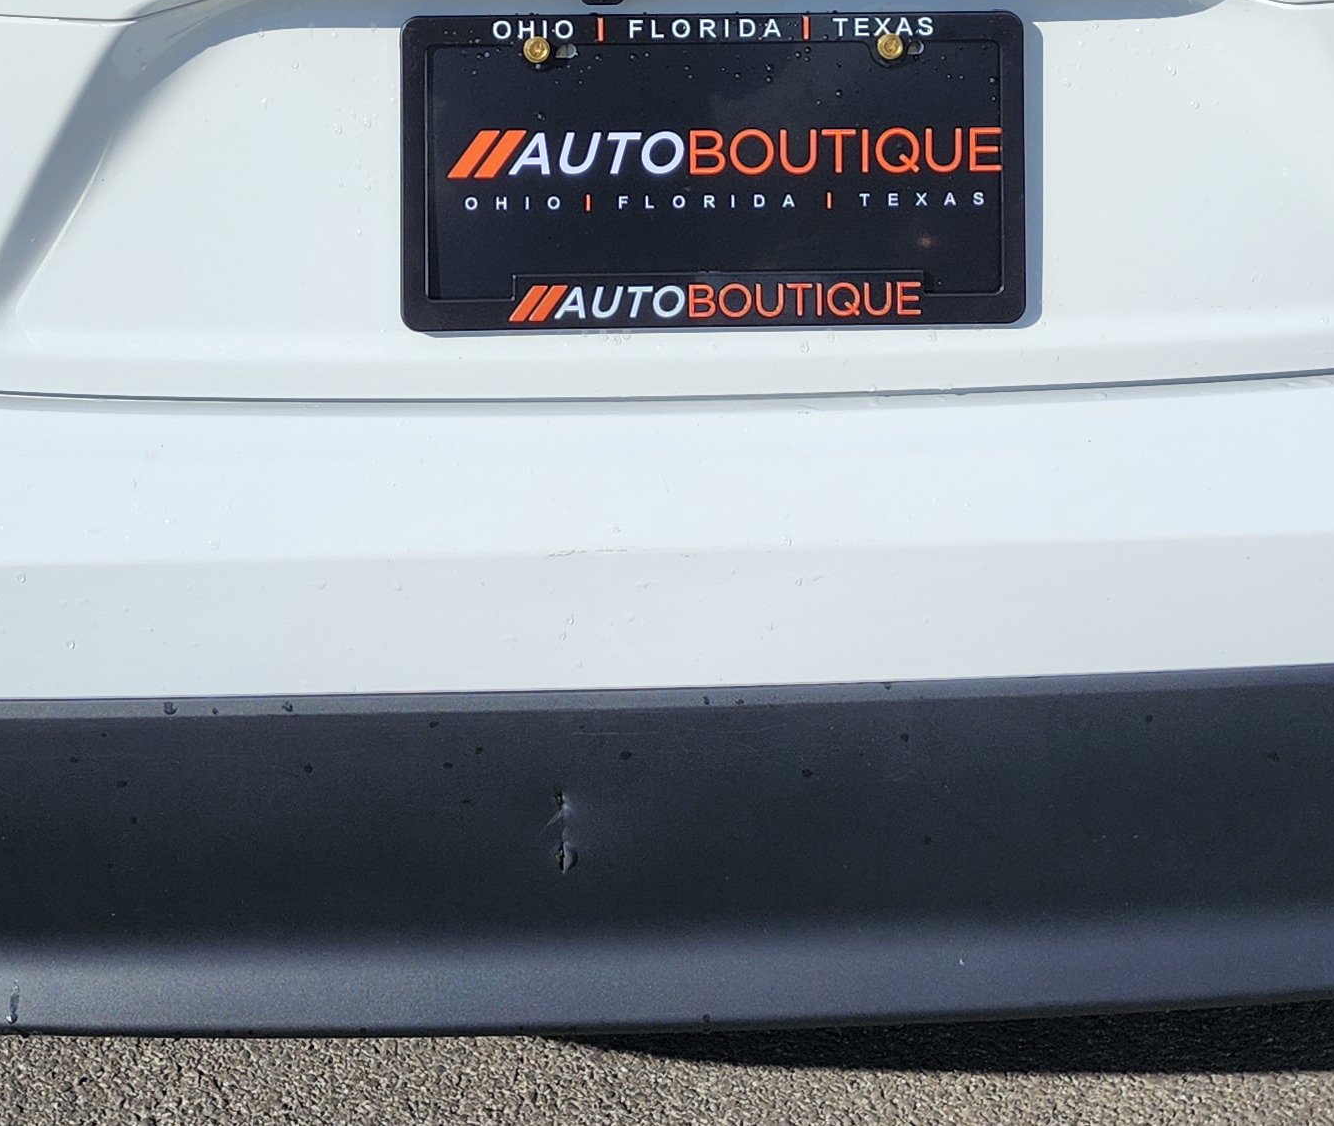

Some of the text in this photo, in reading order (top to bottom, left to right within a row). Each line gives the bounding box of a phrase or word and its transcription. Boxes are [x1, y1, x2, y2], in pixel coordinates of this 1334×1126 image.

[492, 16, 935, 41] OHIO FLORIDA TEXAS
[508, 126, 1004, 176] AUTOBOUTIQUE
[464, 191, 986, 212] OHIO FLORIDA TEXAS
[555, 281, 922, 322] AUTOBOUTIQUE
